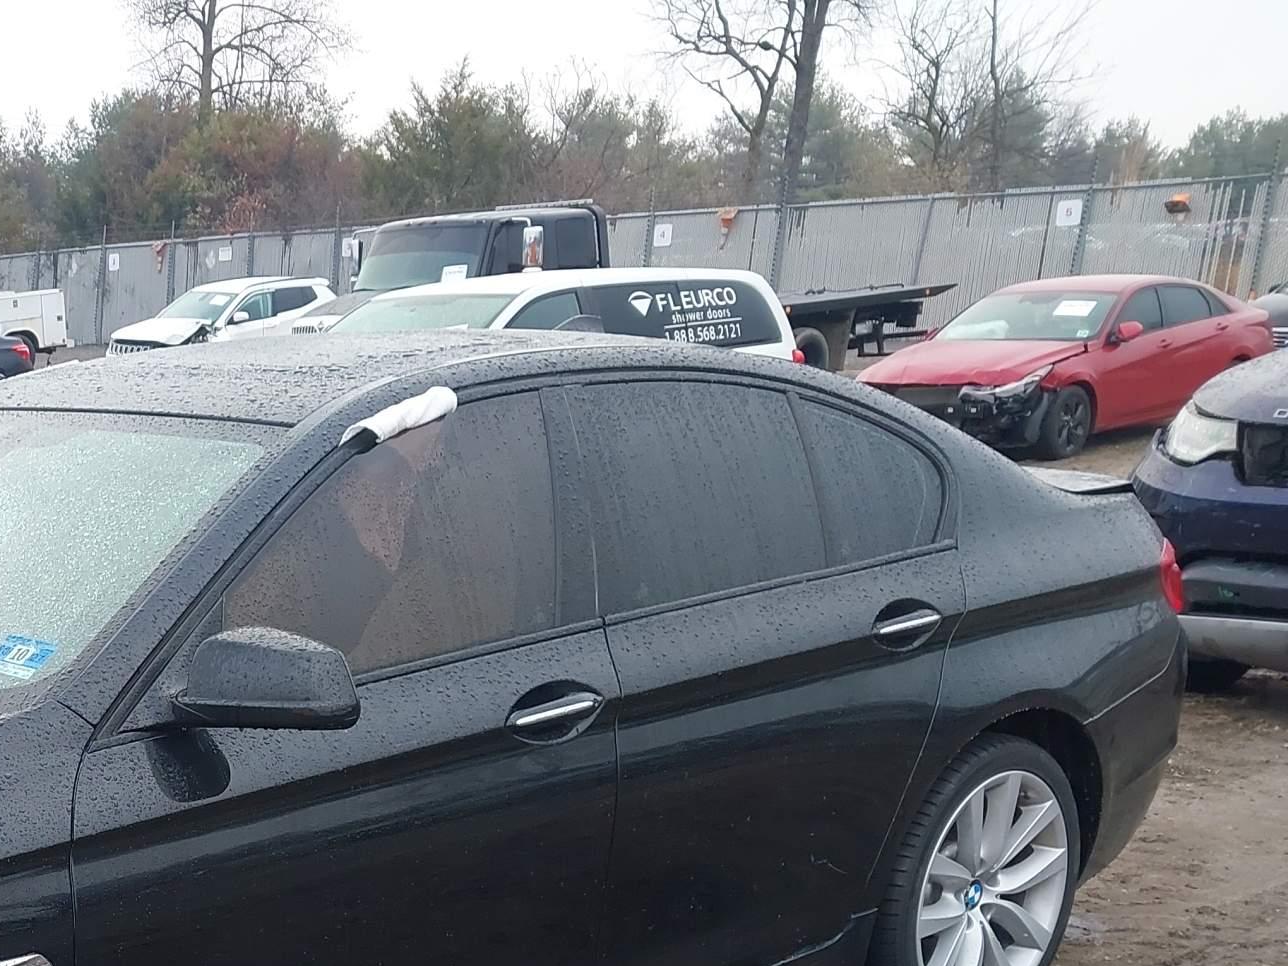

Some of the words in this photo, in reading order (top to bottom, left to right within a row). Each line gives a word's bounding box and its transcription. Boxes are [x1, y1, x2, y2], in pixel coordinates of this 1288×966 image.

[655, 287, 737, 313] FLEURCO
[672, 311, 704, 324] shower
[706, 307, 731, 320] doors
[9, 648, 30, 661] 10
